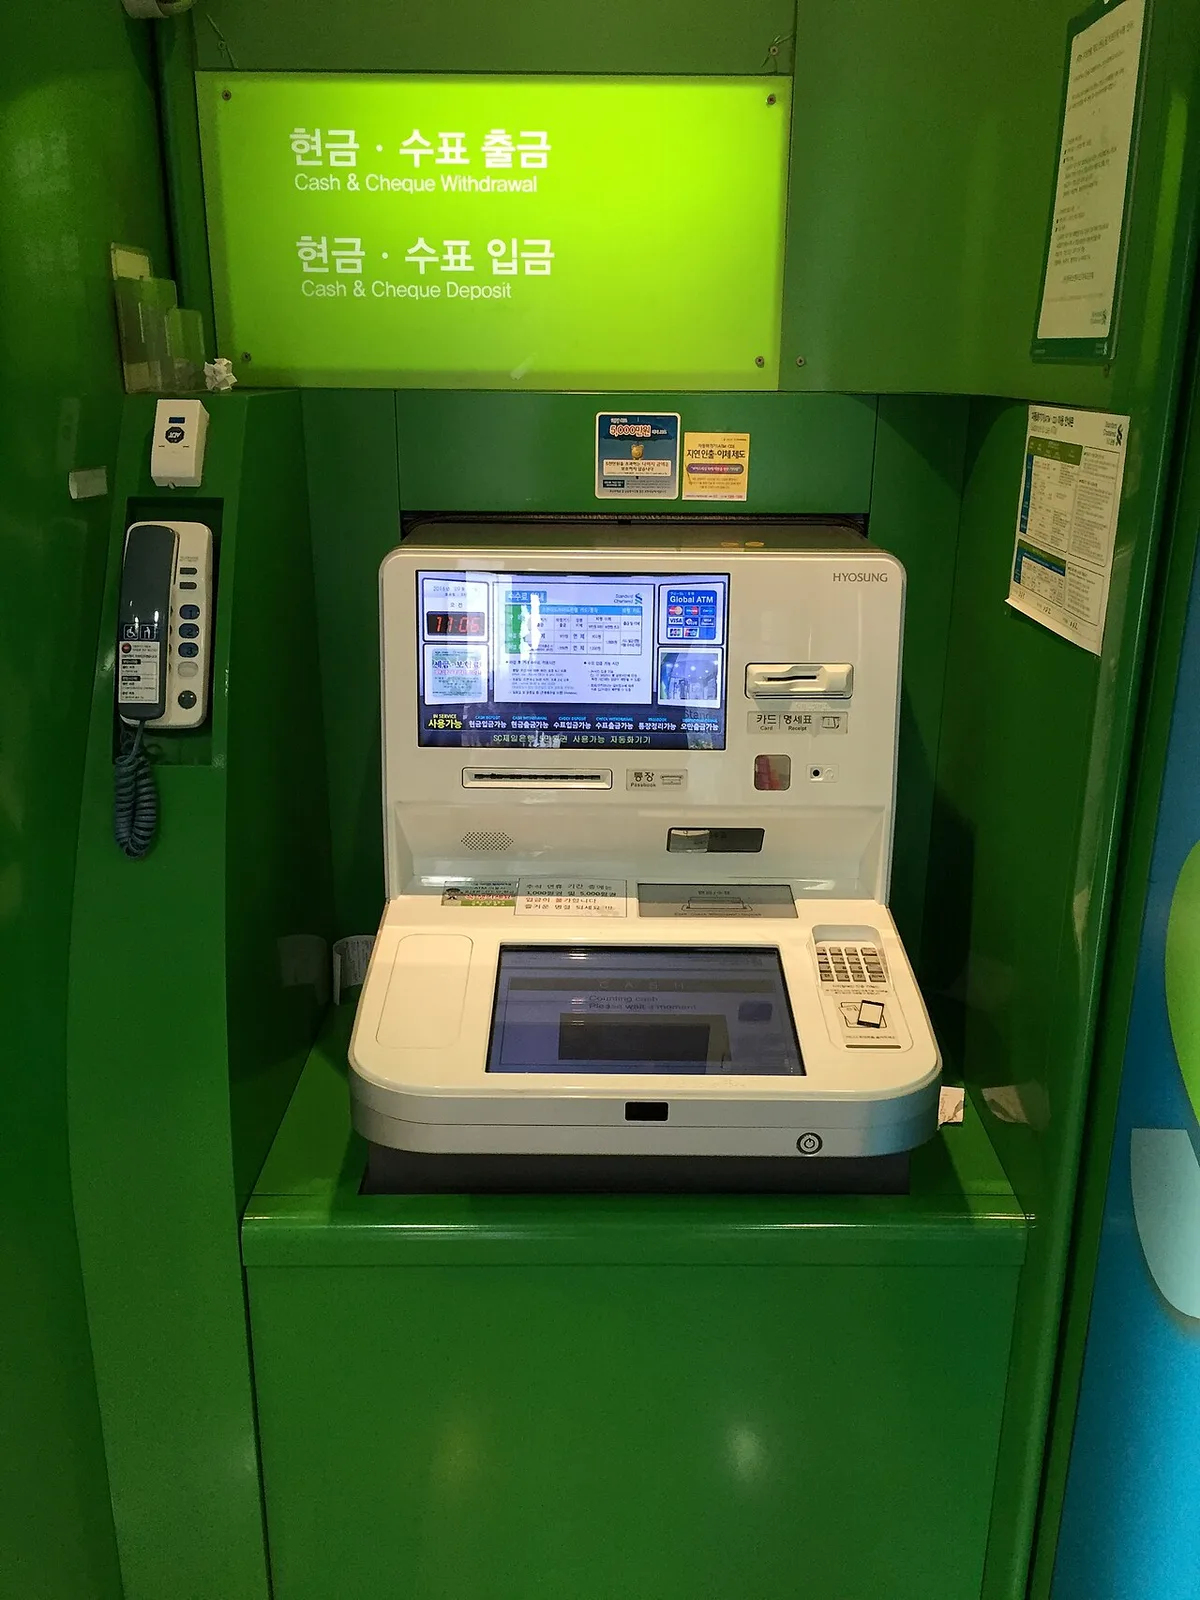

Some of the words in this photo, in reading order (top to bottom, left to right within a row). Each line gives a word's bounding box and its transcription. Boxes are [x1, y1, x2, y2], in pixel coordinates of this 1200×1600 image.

[289, 127, 360, 167] 현금
[399, 128, 471, 168] 수표
[480, 128, 552, 169] 출금
[294, 173, 341, 191] Cash
[346, 173, 361, 191] &
[365, 173, 436, 194] Cheque
[440, 174, 538, 193] Withdrawal
[296, 235, 366, 274] 현금
[404, 236, 475, 275] 수표
[487, 237, 555, 276] 입금
[301, 280, 347, 297] Cash
[353, 280, 366, 297] &
[371, 280, 441, 300] Cheque
[446, 281, 512, 301] Deposit
[832, 572, 888, 583] HYOSUNG
[669, 595, 695, 603] Global
[696, 595, 714, 603] ATM
[428, 719, 463, 729] 사용가능
[756, 714, 777, 725] 카드
[783, 714, 813, 725] 명세표
[553, 720, 591, 730] 수표입금가능
[595, 721, 634, 730] 수표출금가능
[638, 721, 677, 731] 통장정리가능
[572, 735, 605, 744] 사용가능
[610, 735, 651, 744] 자동화기기
[633, 771, 655, 782] 통장
[588, 994, 633, 1004] Counting
